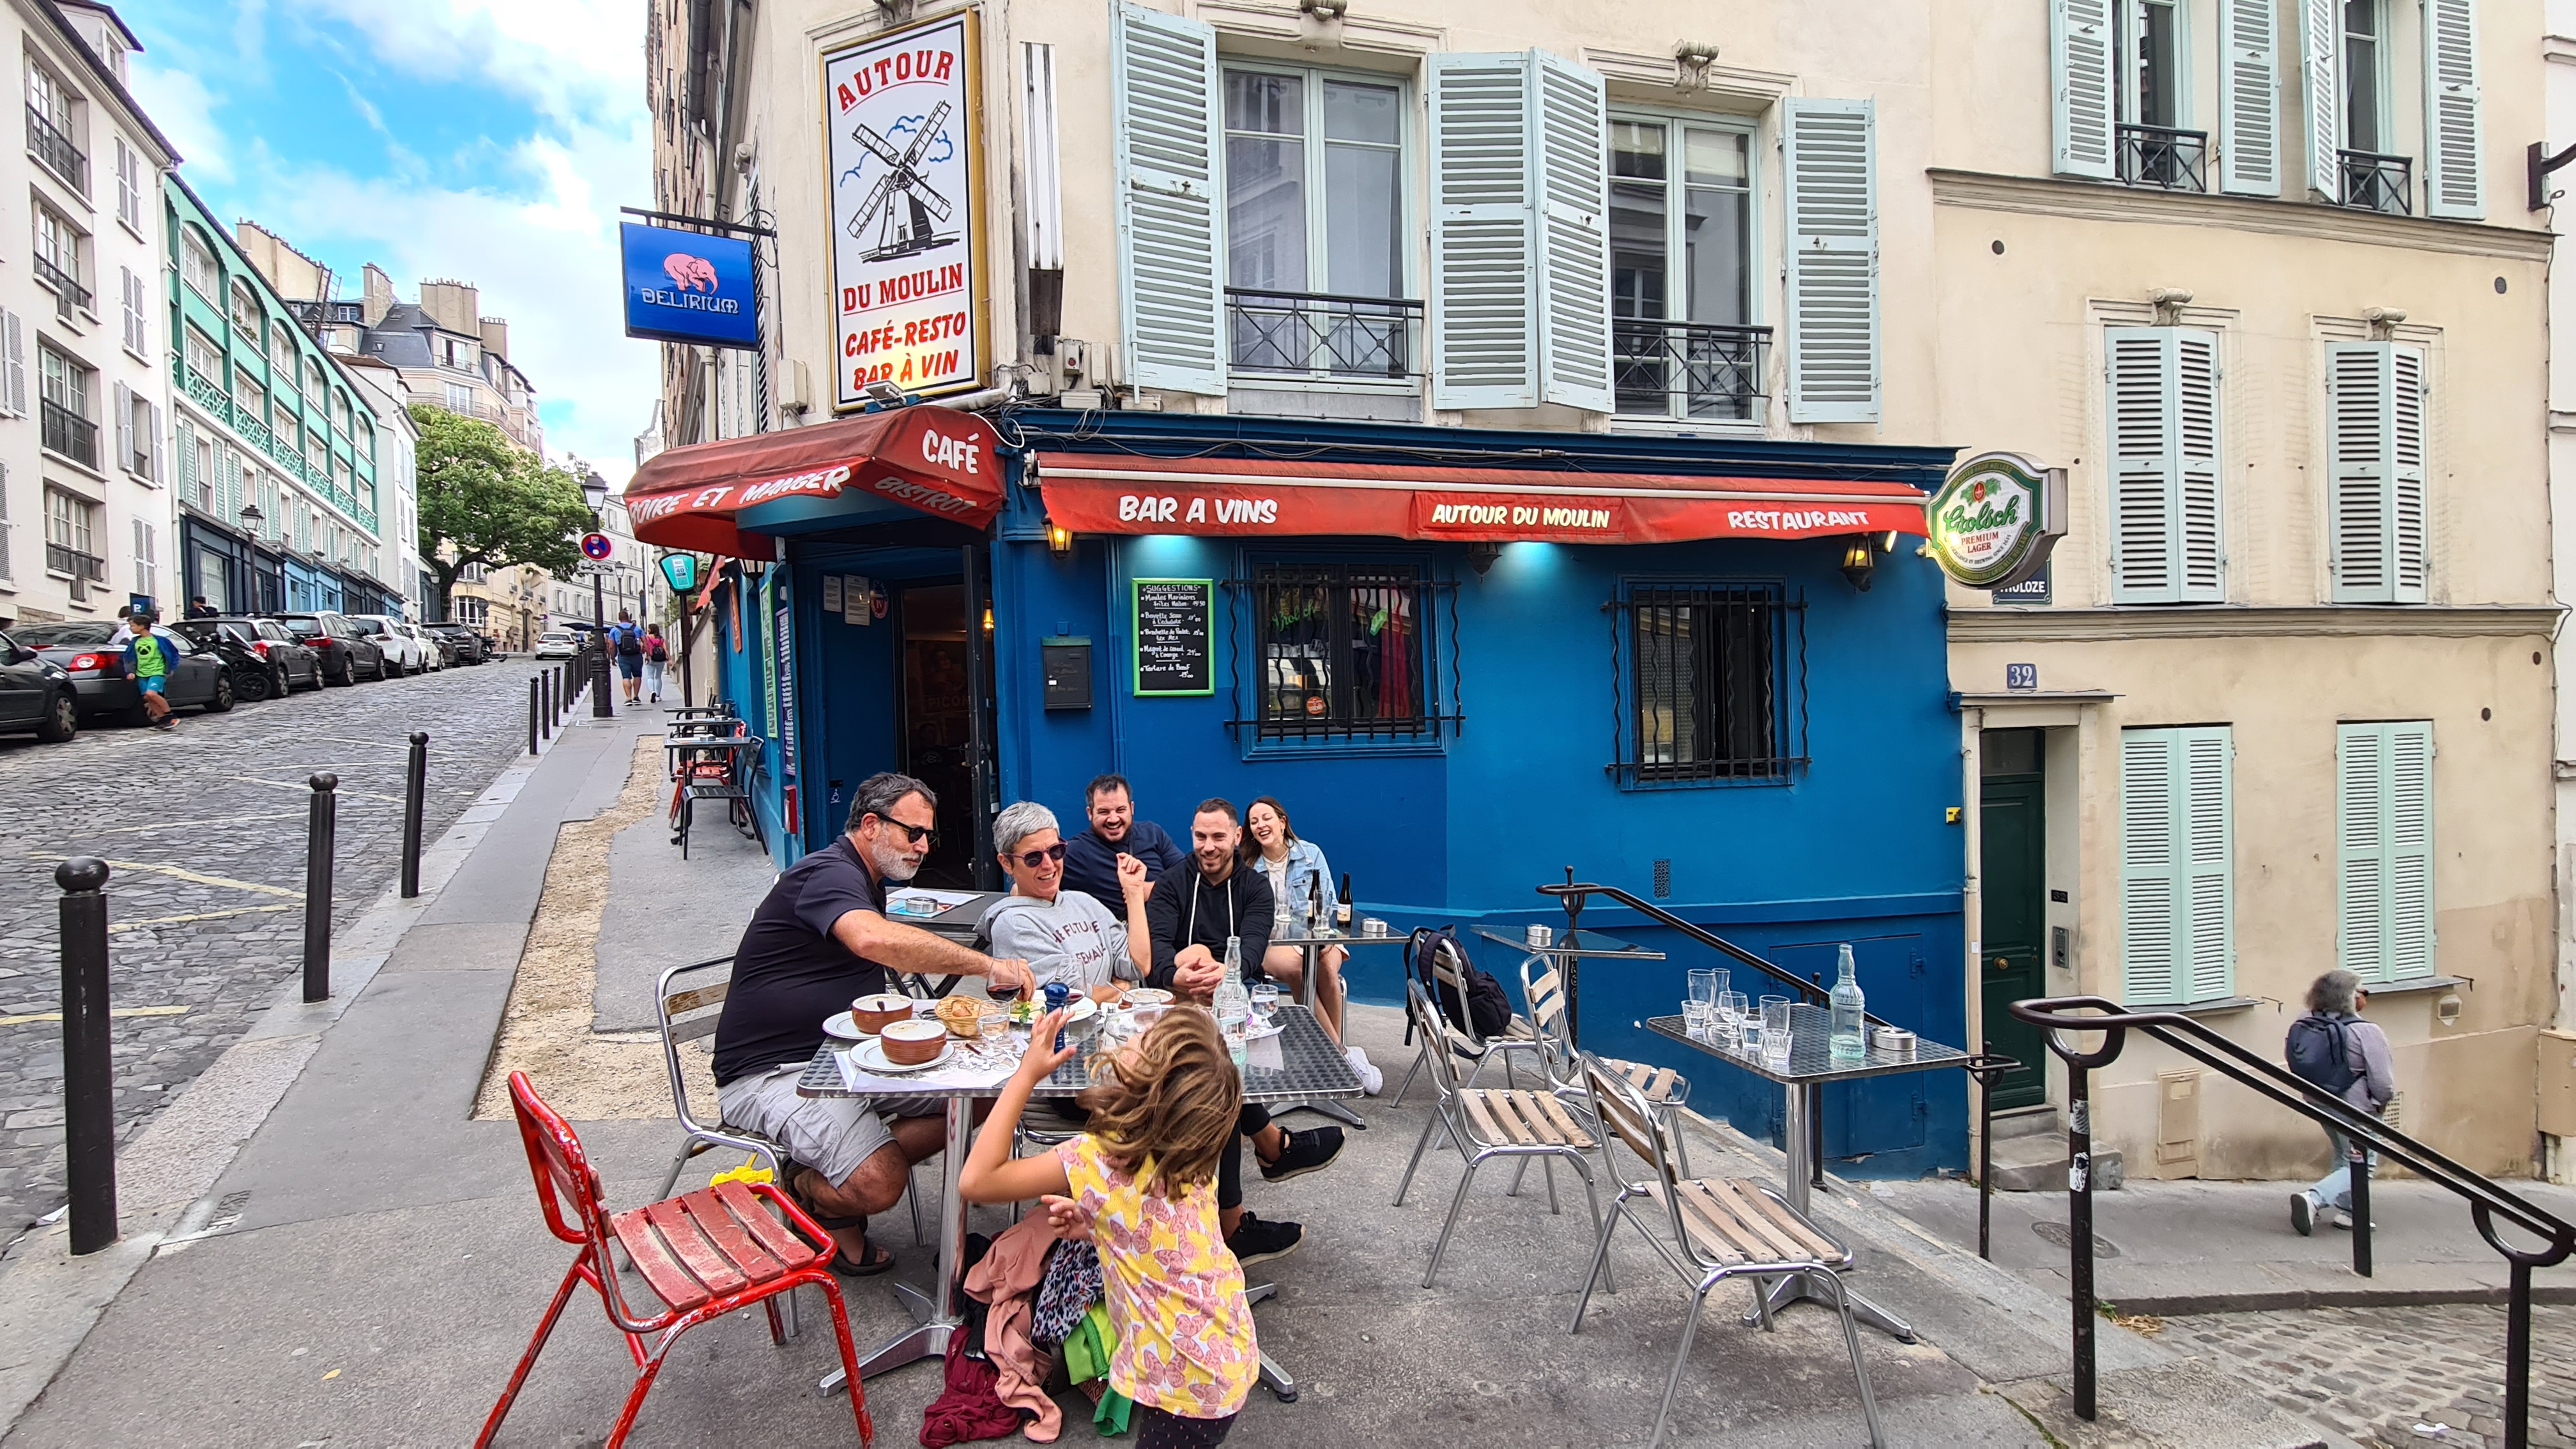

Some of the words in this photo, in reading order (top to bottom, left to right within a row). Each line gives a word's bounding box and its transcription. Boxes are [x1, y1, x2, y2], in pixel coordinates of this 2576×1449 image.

[837, 50, 954, 111] AUTOUR
[641, 288, 739, 314] DELIRIUM
[843, 283, 870, 312] DU
[878, 263, 962, 305] MOULIN
[845, 310, 966, 357] CAFÉ-RESTO
[854, 362, 893, 391] BAR
[900, 353, 912, 382] À
[921, 349, 958, 378] VIN
[923, 429, 980, 474] CAFÉ
[628, 493, 690, 528] BOIRE
[691, 486, 734, 508] ET
[739, 465, 851, 505] MANGER
[874, 475, 977, 515] BISTROT
[1119, 495, 1178, 523] BAR
[1185, 498, 1206, 523] A
[1215, 498, 1278, 524] VINS
[1431, 503, 1508, 525] AUTOUR
[1512, 507, 1538, 526] DU
[1542, 507, 1610, 528] MOULIN
[1728, 510, 1869, 531] RESTAURANT
[1943, 494, 2018, 535] Grolsch
[1961, 531, 1999, 546] PREMIUM
[1967, 542, 1991, 553] LAGER
[2000, 581, 2046, 593] OLOZE
[2011, 666, 2033, 687] 32
